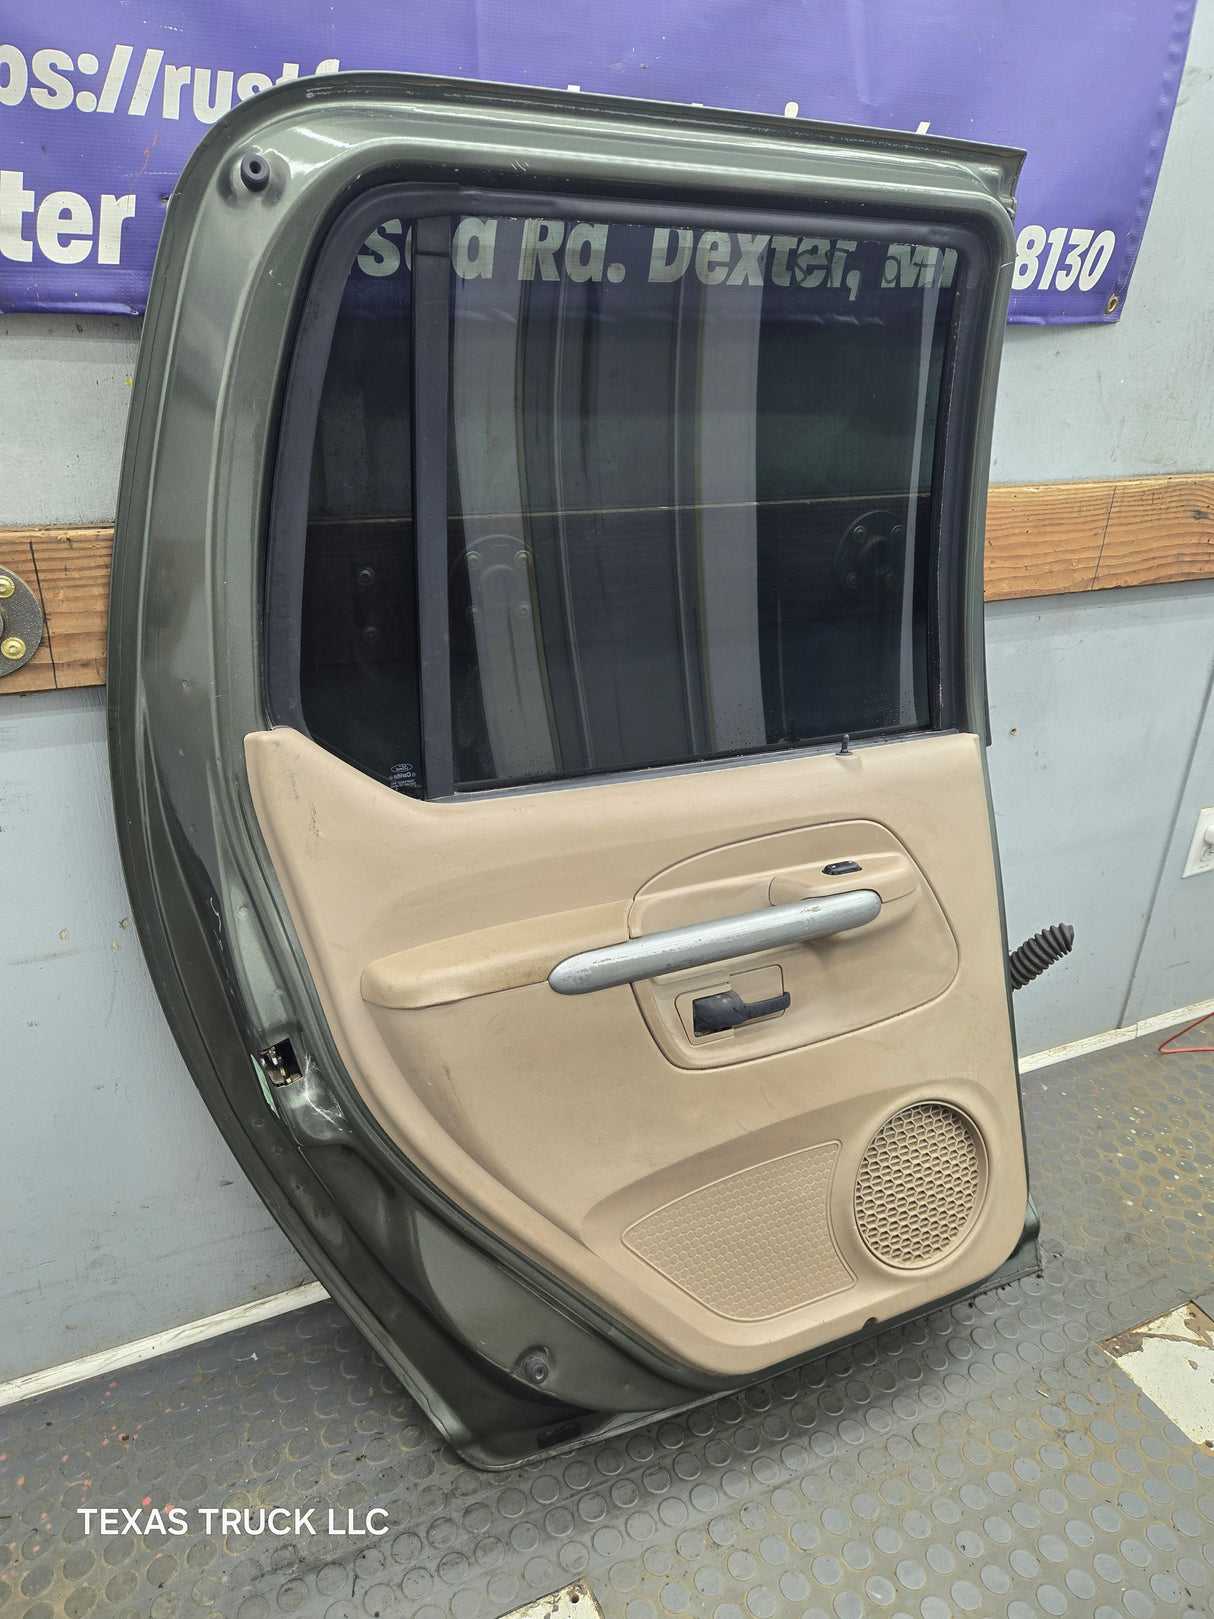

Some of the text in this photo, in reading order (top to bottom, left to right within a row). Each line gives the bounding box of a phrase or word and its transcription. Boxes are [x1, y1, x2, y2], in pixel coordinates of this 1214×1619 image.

[0, 170, 136, 265] ter
[648, 228, 860, 301] Dexter,
[1011, 225, 1116, 292] 8130
